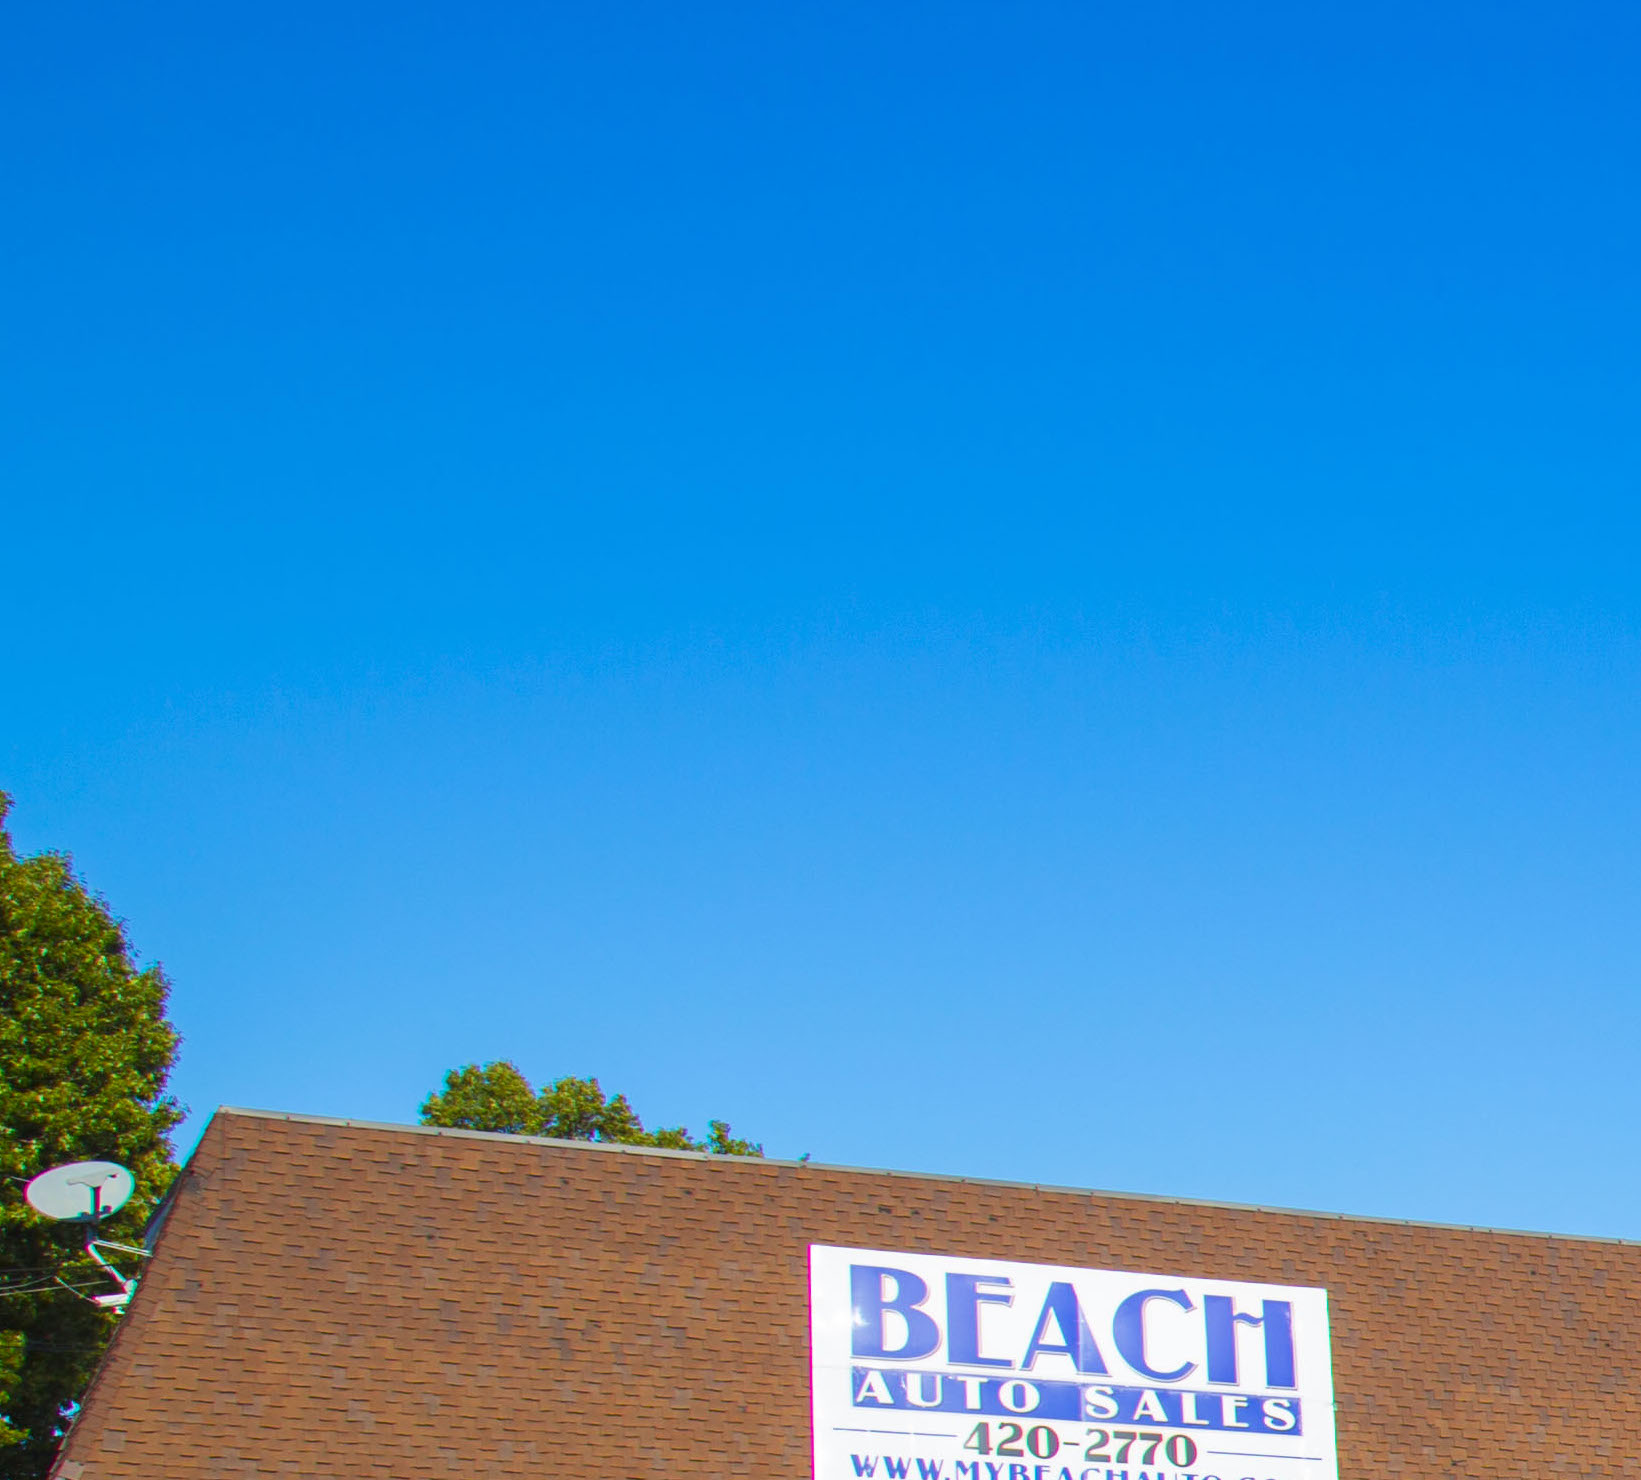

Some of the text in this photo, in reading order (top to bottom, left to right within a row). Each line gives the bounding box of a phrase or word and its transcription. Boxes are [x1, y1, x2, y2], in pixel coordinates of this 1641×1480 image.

[850, 1264, 1298, 1390] BEACH
[855, 1371, 1297, 1431] AUTO SALES
[963, 1422, 1197, 1468] 420-2770
